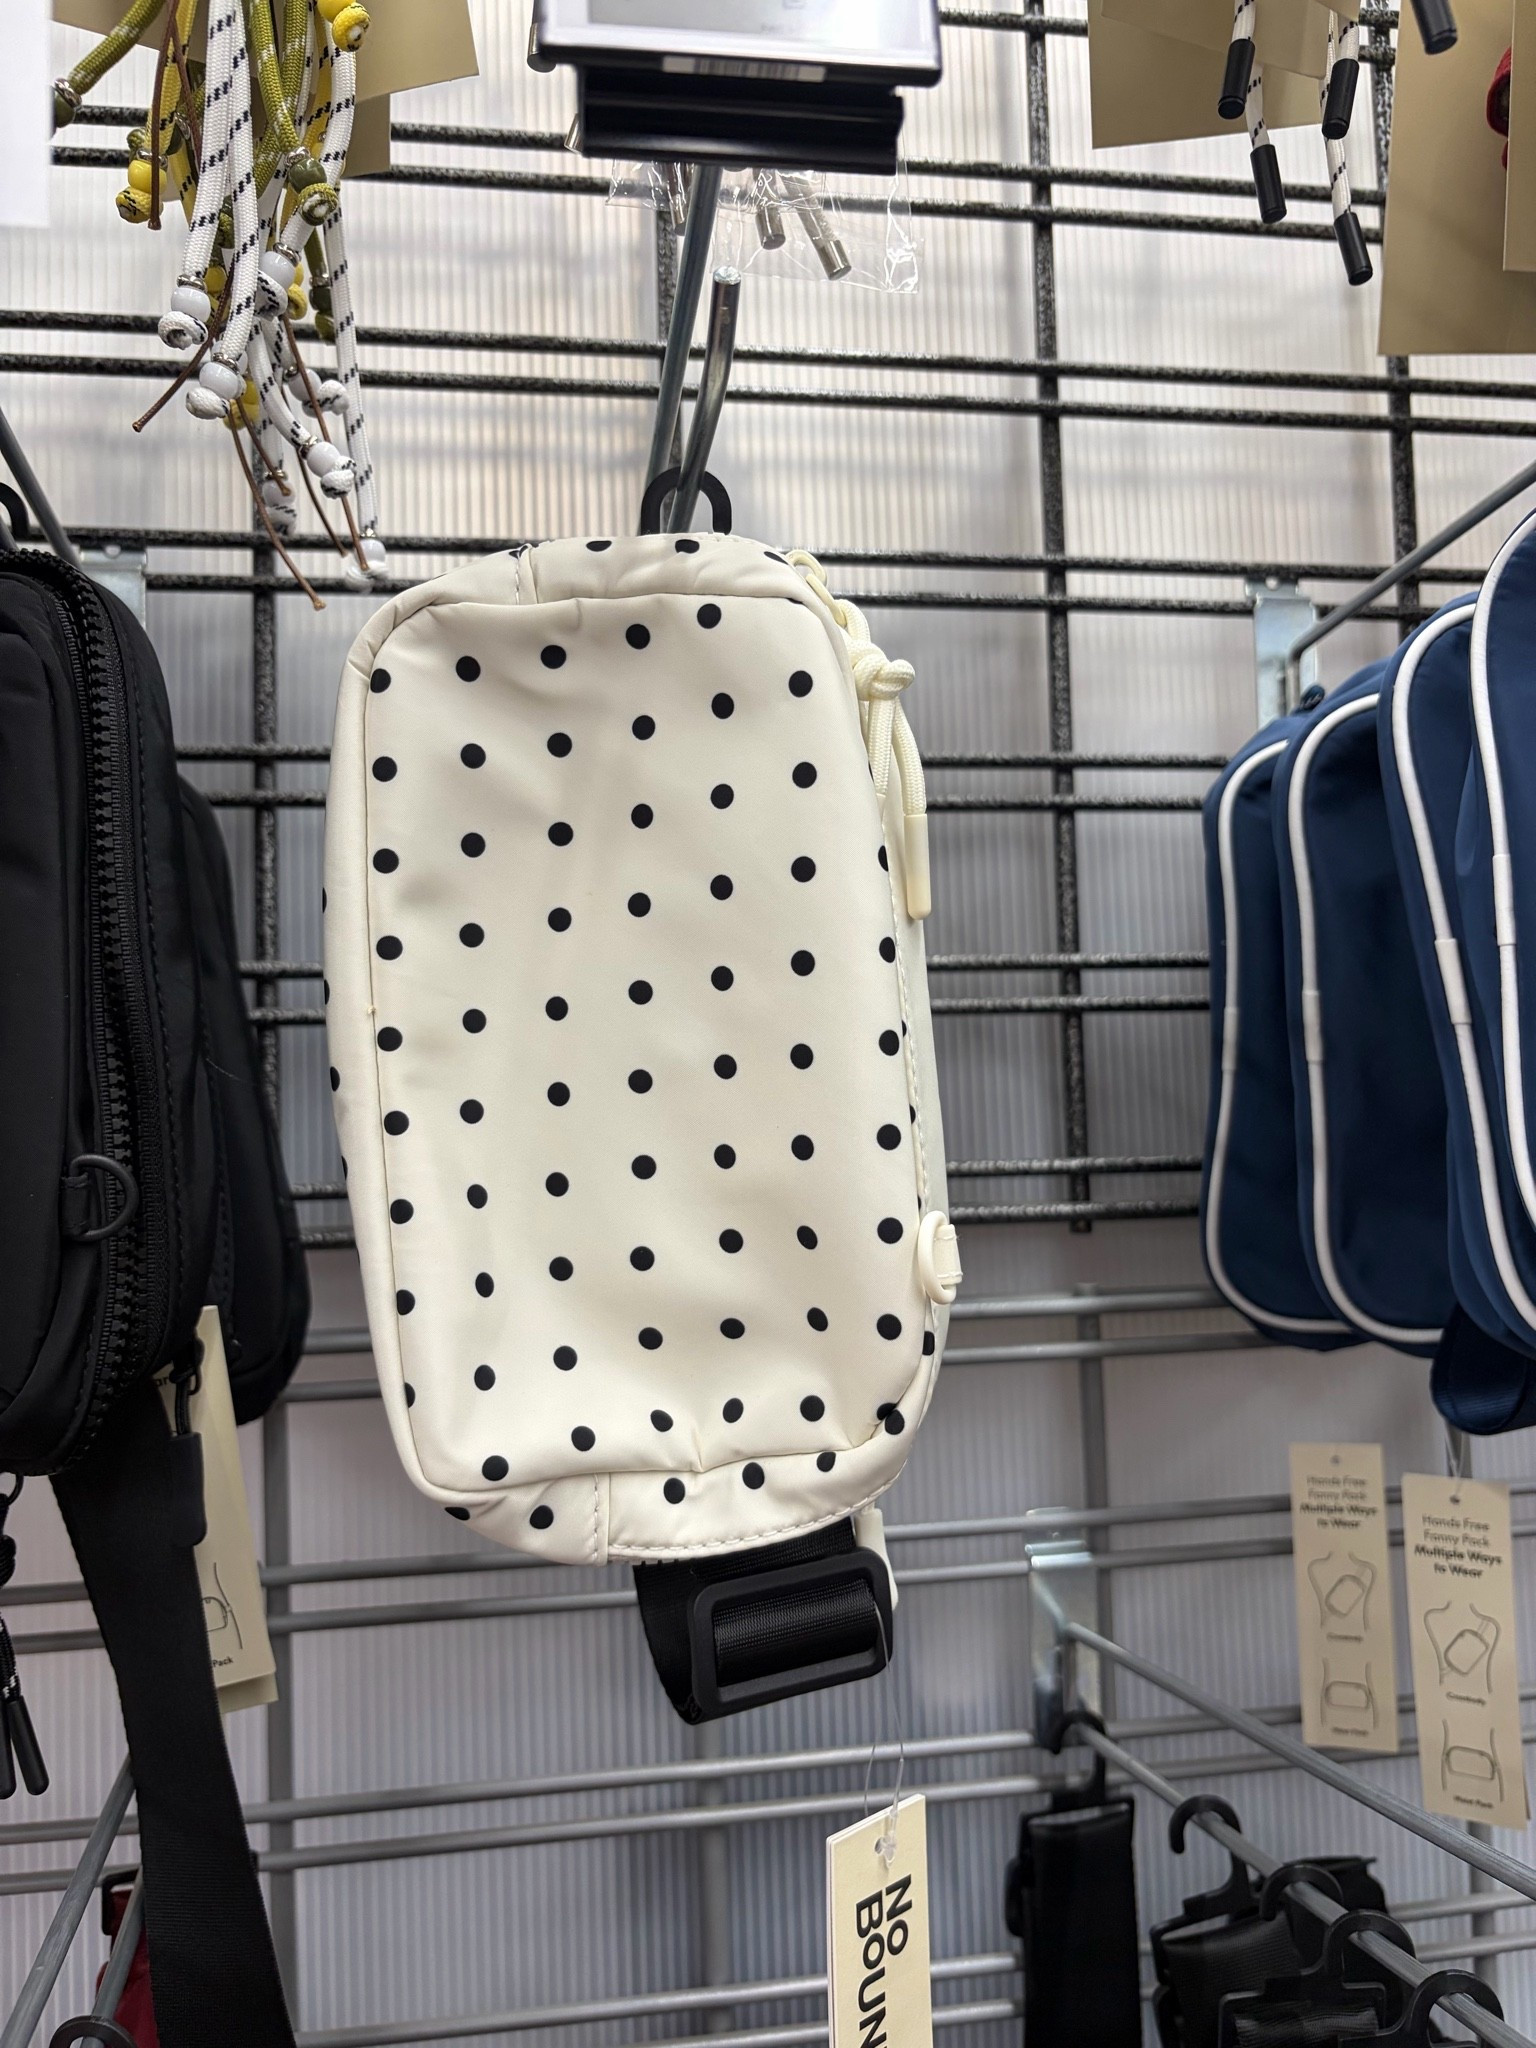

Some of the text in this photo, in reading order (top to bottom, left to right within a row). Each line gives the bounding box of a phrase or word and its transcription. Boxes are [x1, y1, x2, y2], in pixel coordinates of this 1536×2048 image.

[1422, 1514, 1489, 1532] Hands Free
[1424, 1528, 1489, 1548] Fanny Pack
[1414, 1543, 1502, 1568] Multiple Ways
[1434, 1562, 1483, 1578] to Wear
[885, 1873, 913, 1956] NO
[856, 1889, 888, 2048] BOUN
